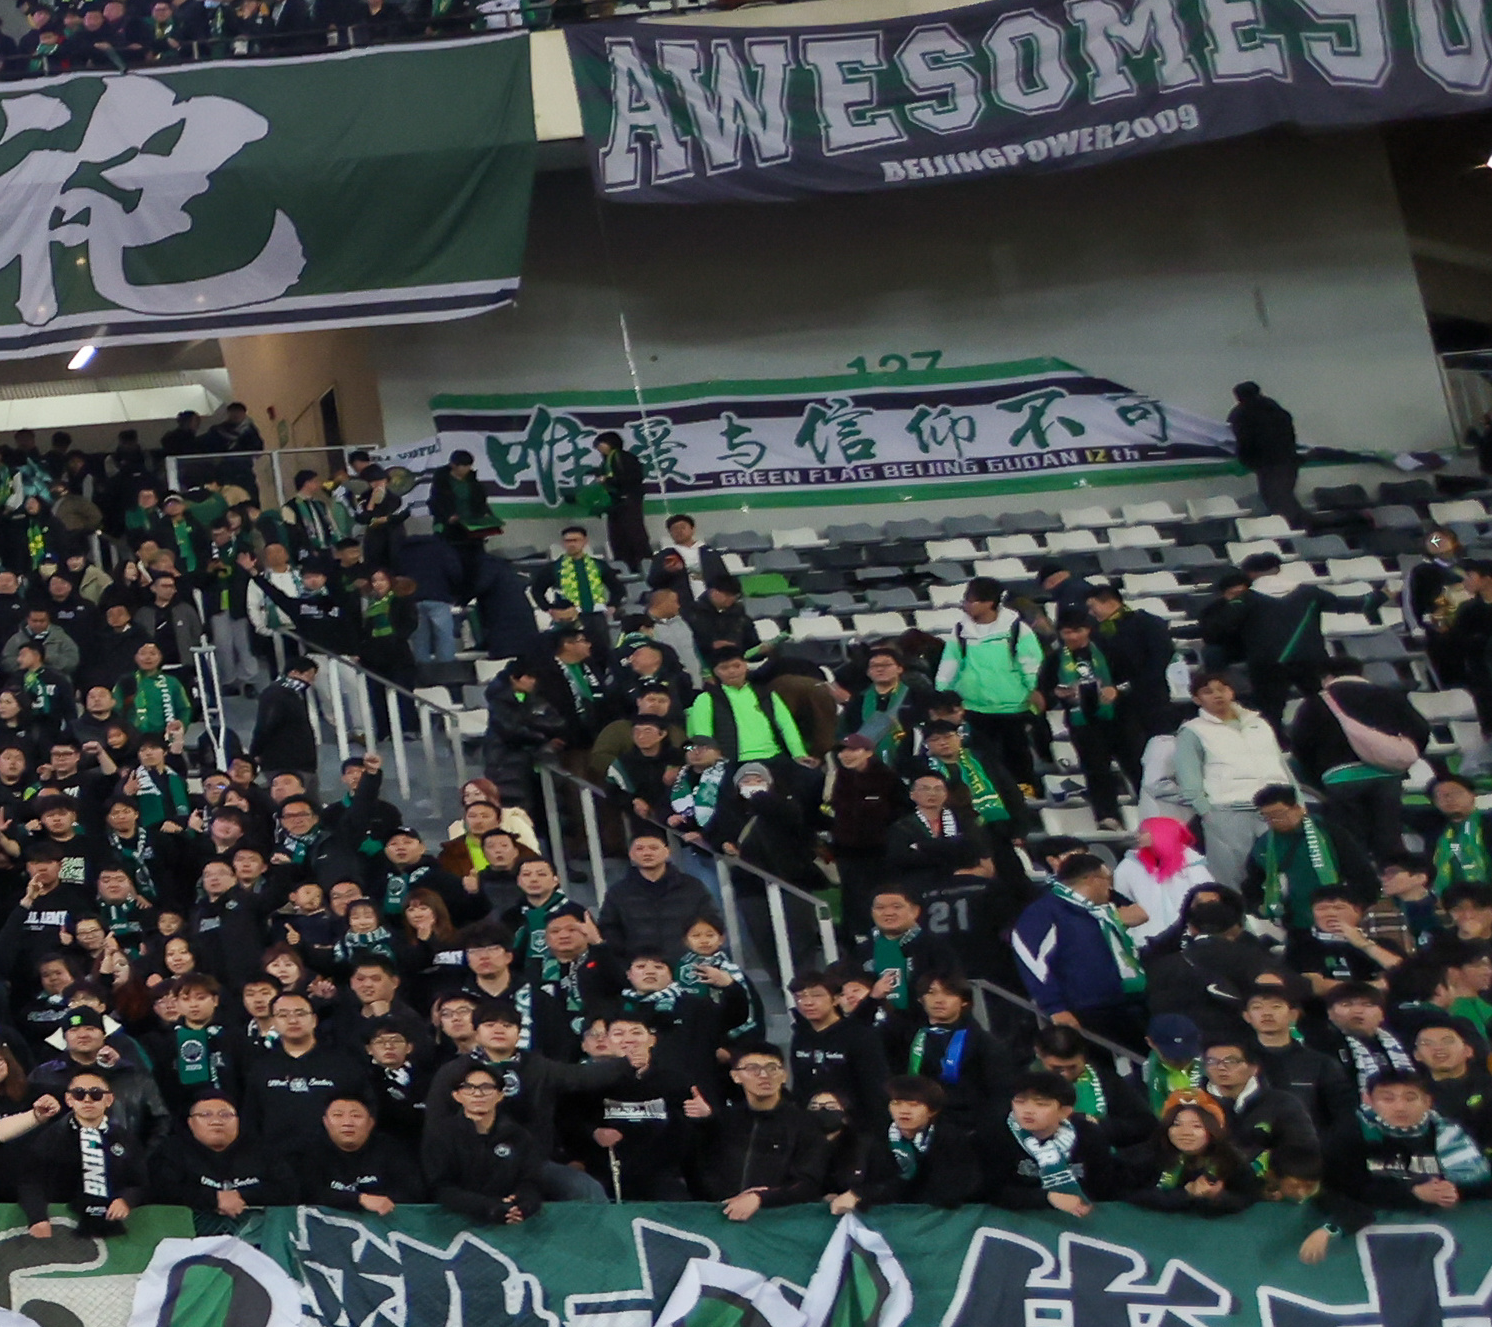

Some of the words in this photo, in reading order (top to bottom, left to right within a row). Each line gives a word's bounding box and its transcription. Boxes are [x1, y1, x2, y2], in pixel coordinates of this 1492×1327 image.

[880, 103, 1203, 184] BEIJINGPOWER2009
[719, 467, 804, 488] GREEN
[808, 465, 877, 486] FLAG
[880, 460, 981, 483] BEIJING
[987, 453, 1079, 474] GUOAN
[927, 897, 970, 934] 21
